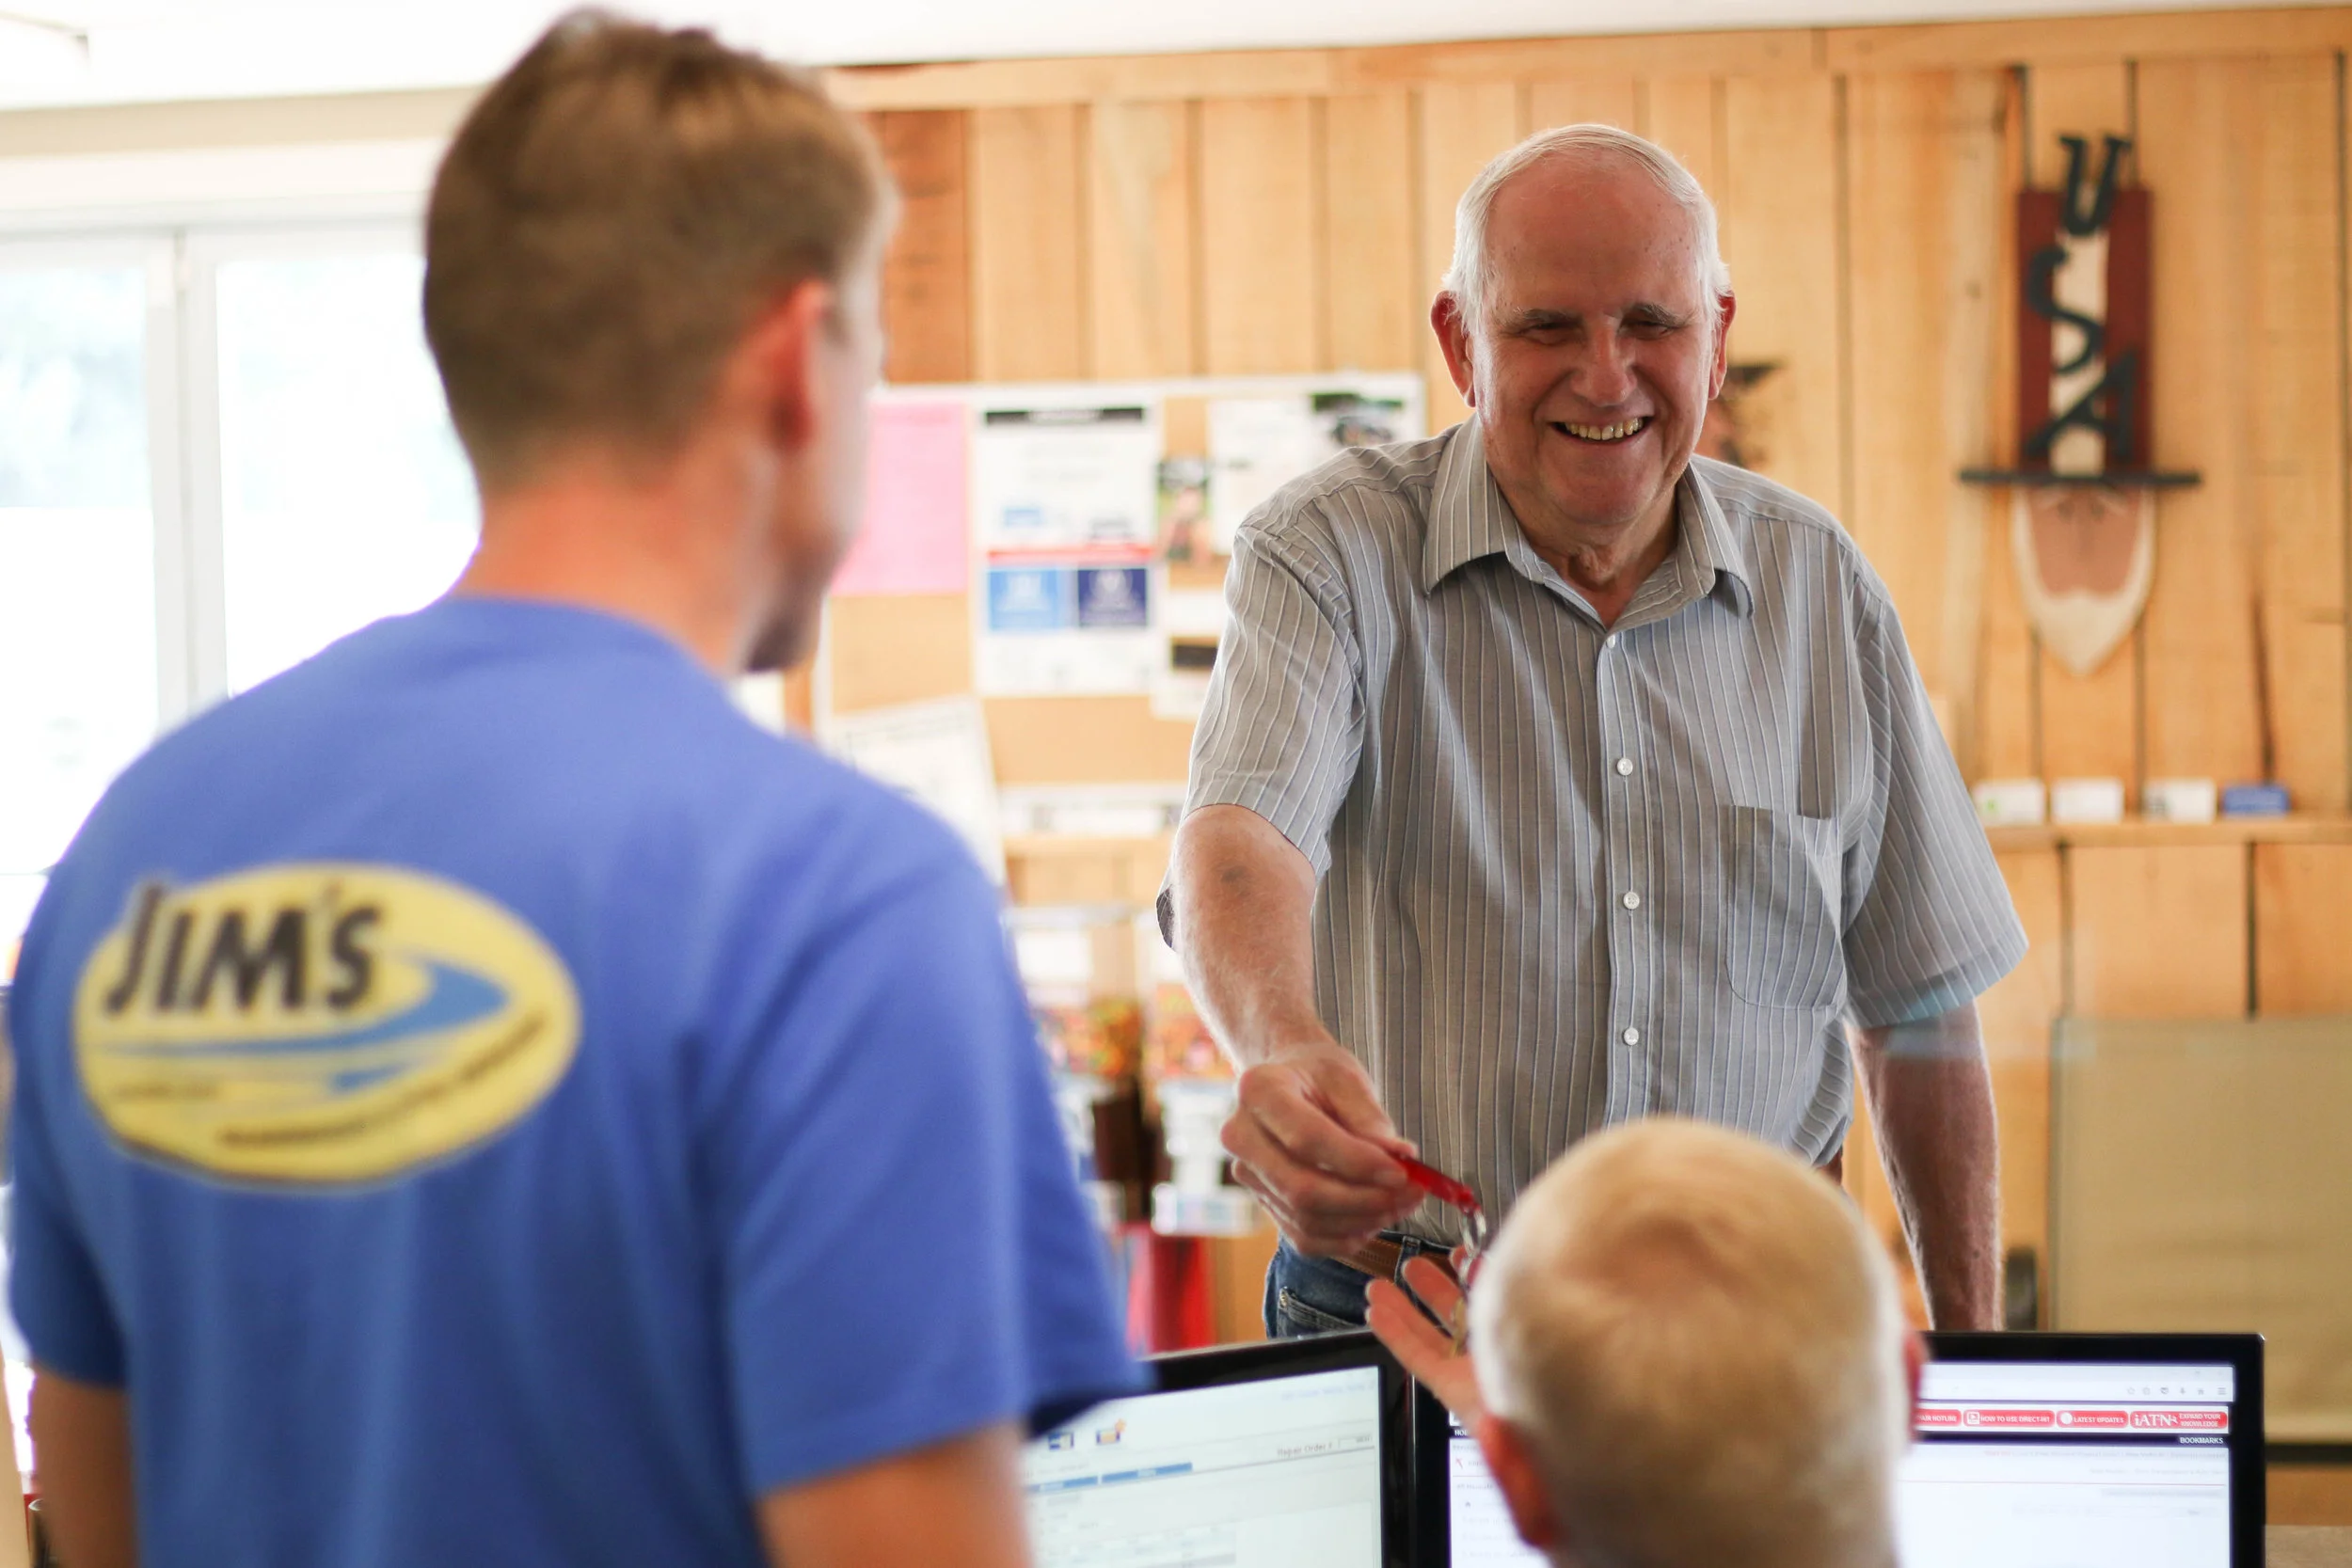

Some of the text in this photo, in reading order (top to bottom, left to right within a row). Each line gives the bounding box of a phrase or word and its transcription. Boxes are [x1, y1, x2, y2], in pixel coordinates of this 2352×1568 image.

[2023, 133, 2138, 461] USA
[103, 880, 384, 1014] JIM'S
[1304, 1443, 1327, 1452] Order
